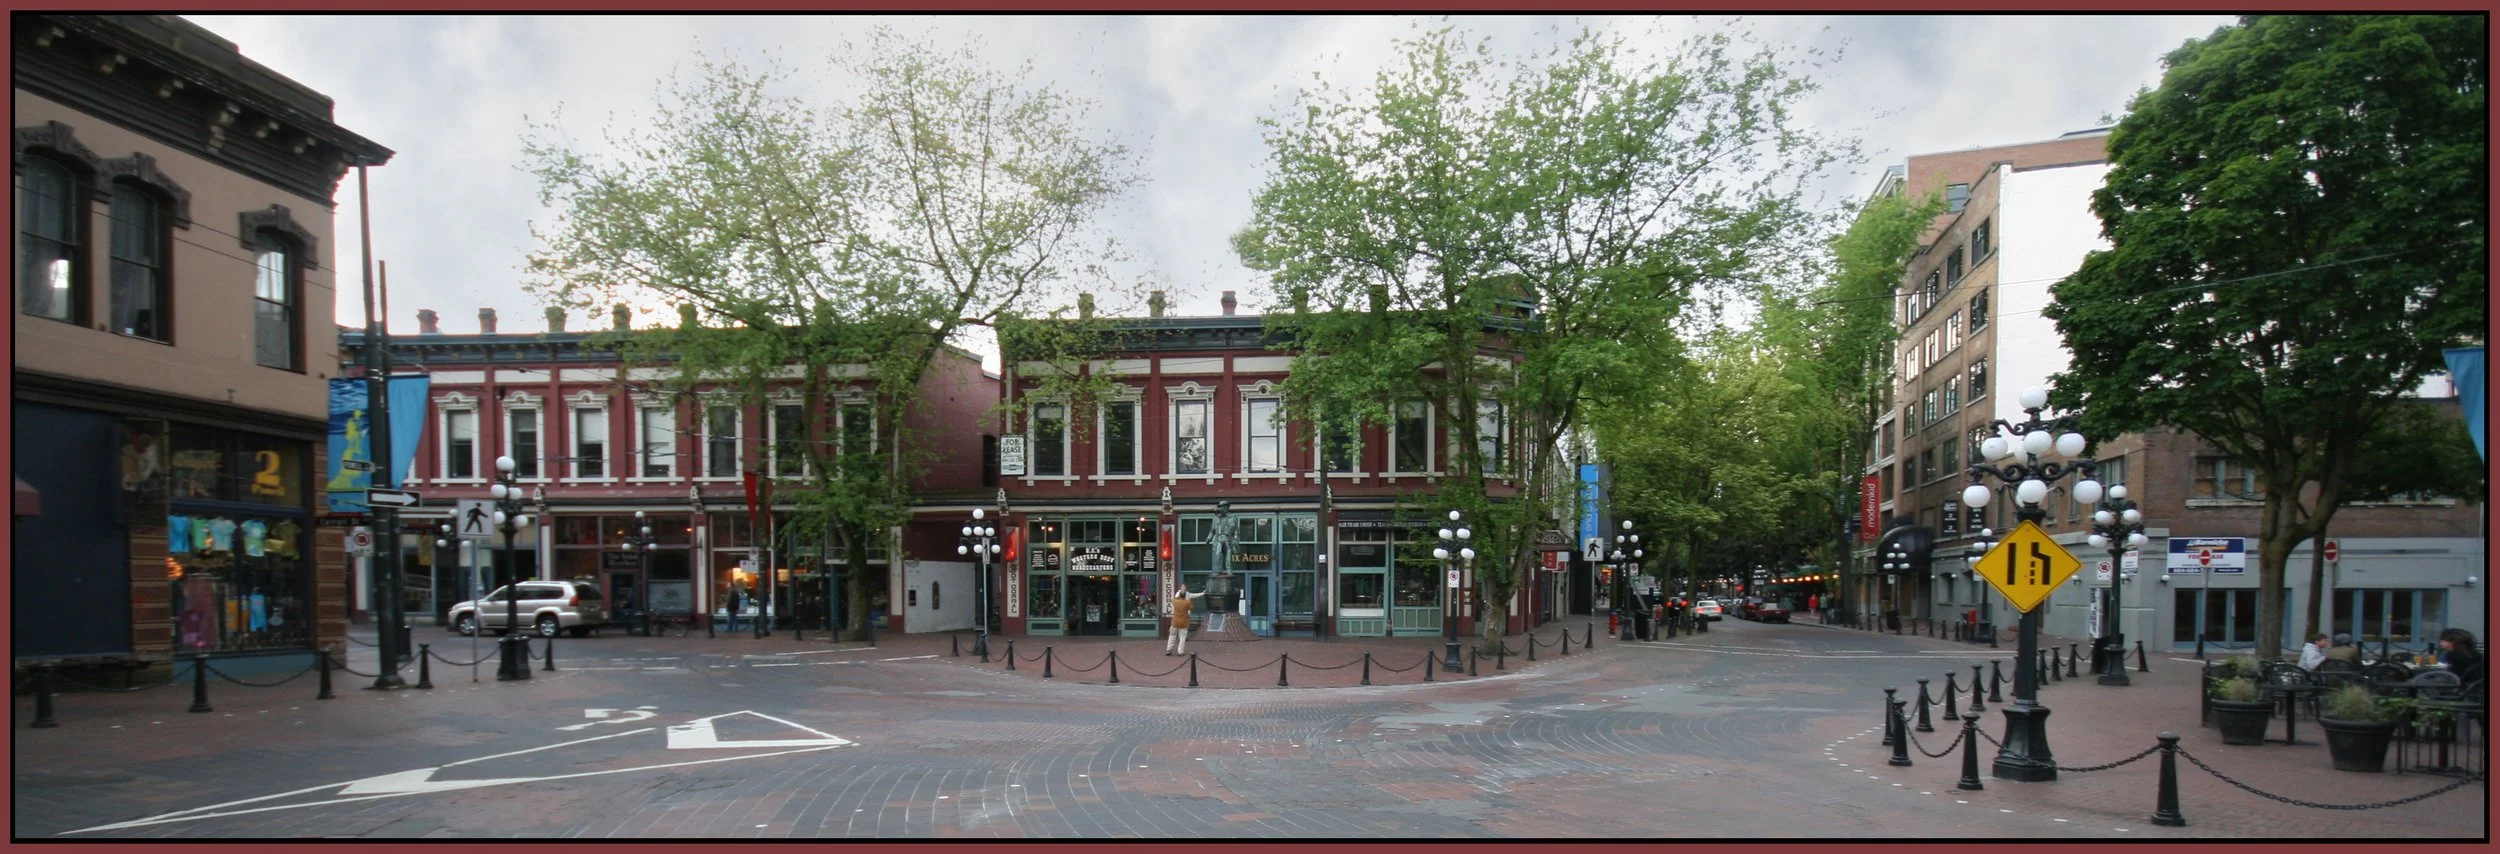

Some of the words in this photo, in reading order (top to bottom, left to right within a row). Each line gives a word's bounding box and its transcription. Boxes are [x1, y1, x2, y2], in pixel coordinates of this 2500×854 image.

[1005, 438, 1018, 446] FOR
[255, 450, 280, 485] 2
[1866, 483, 1876, 528] modernkid
[1070, 553, 1098, 564] WESTERN
[1099, 553, 1115, 563] BOOT
